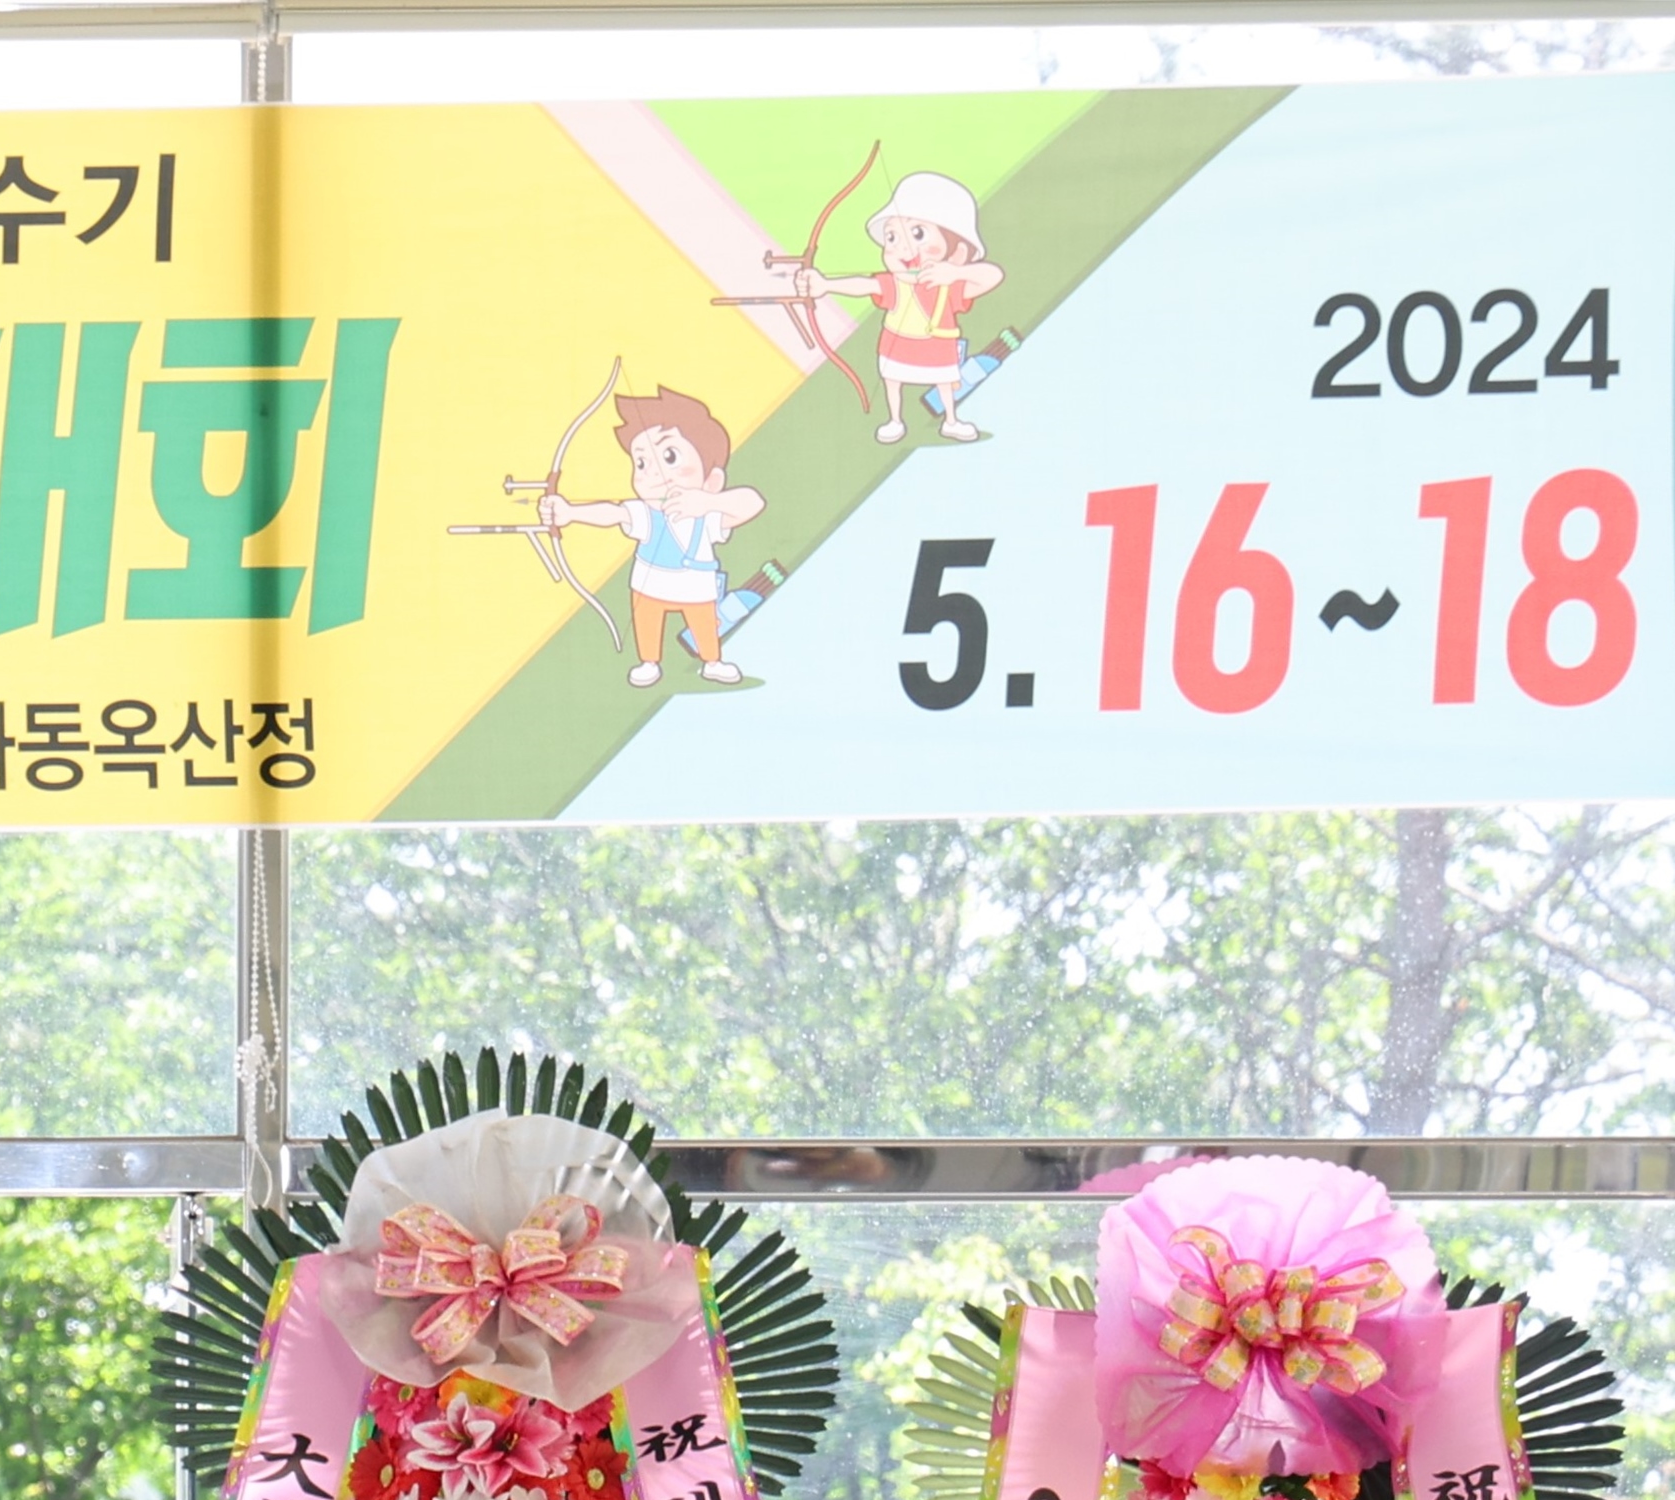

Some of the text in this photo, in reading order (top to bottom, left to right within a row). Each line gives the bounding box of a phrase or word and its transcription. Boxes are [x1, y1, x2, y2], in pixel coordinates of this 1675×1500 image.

[1310, 287, 1621, 400] 2024
[898, 537, 1037, 712] 5.
[637, 1413, 728, 1463] 祝
